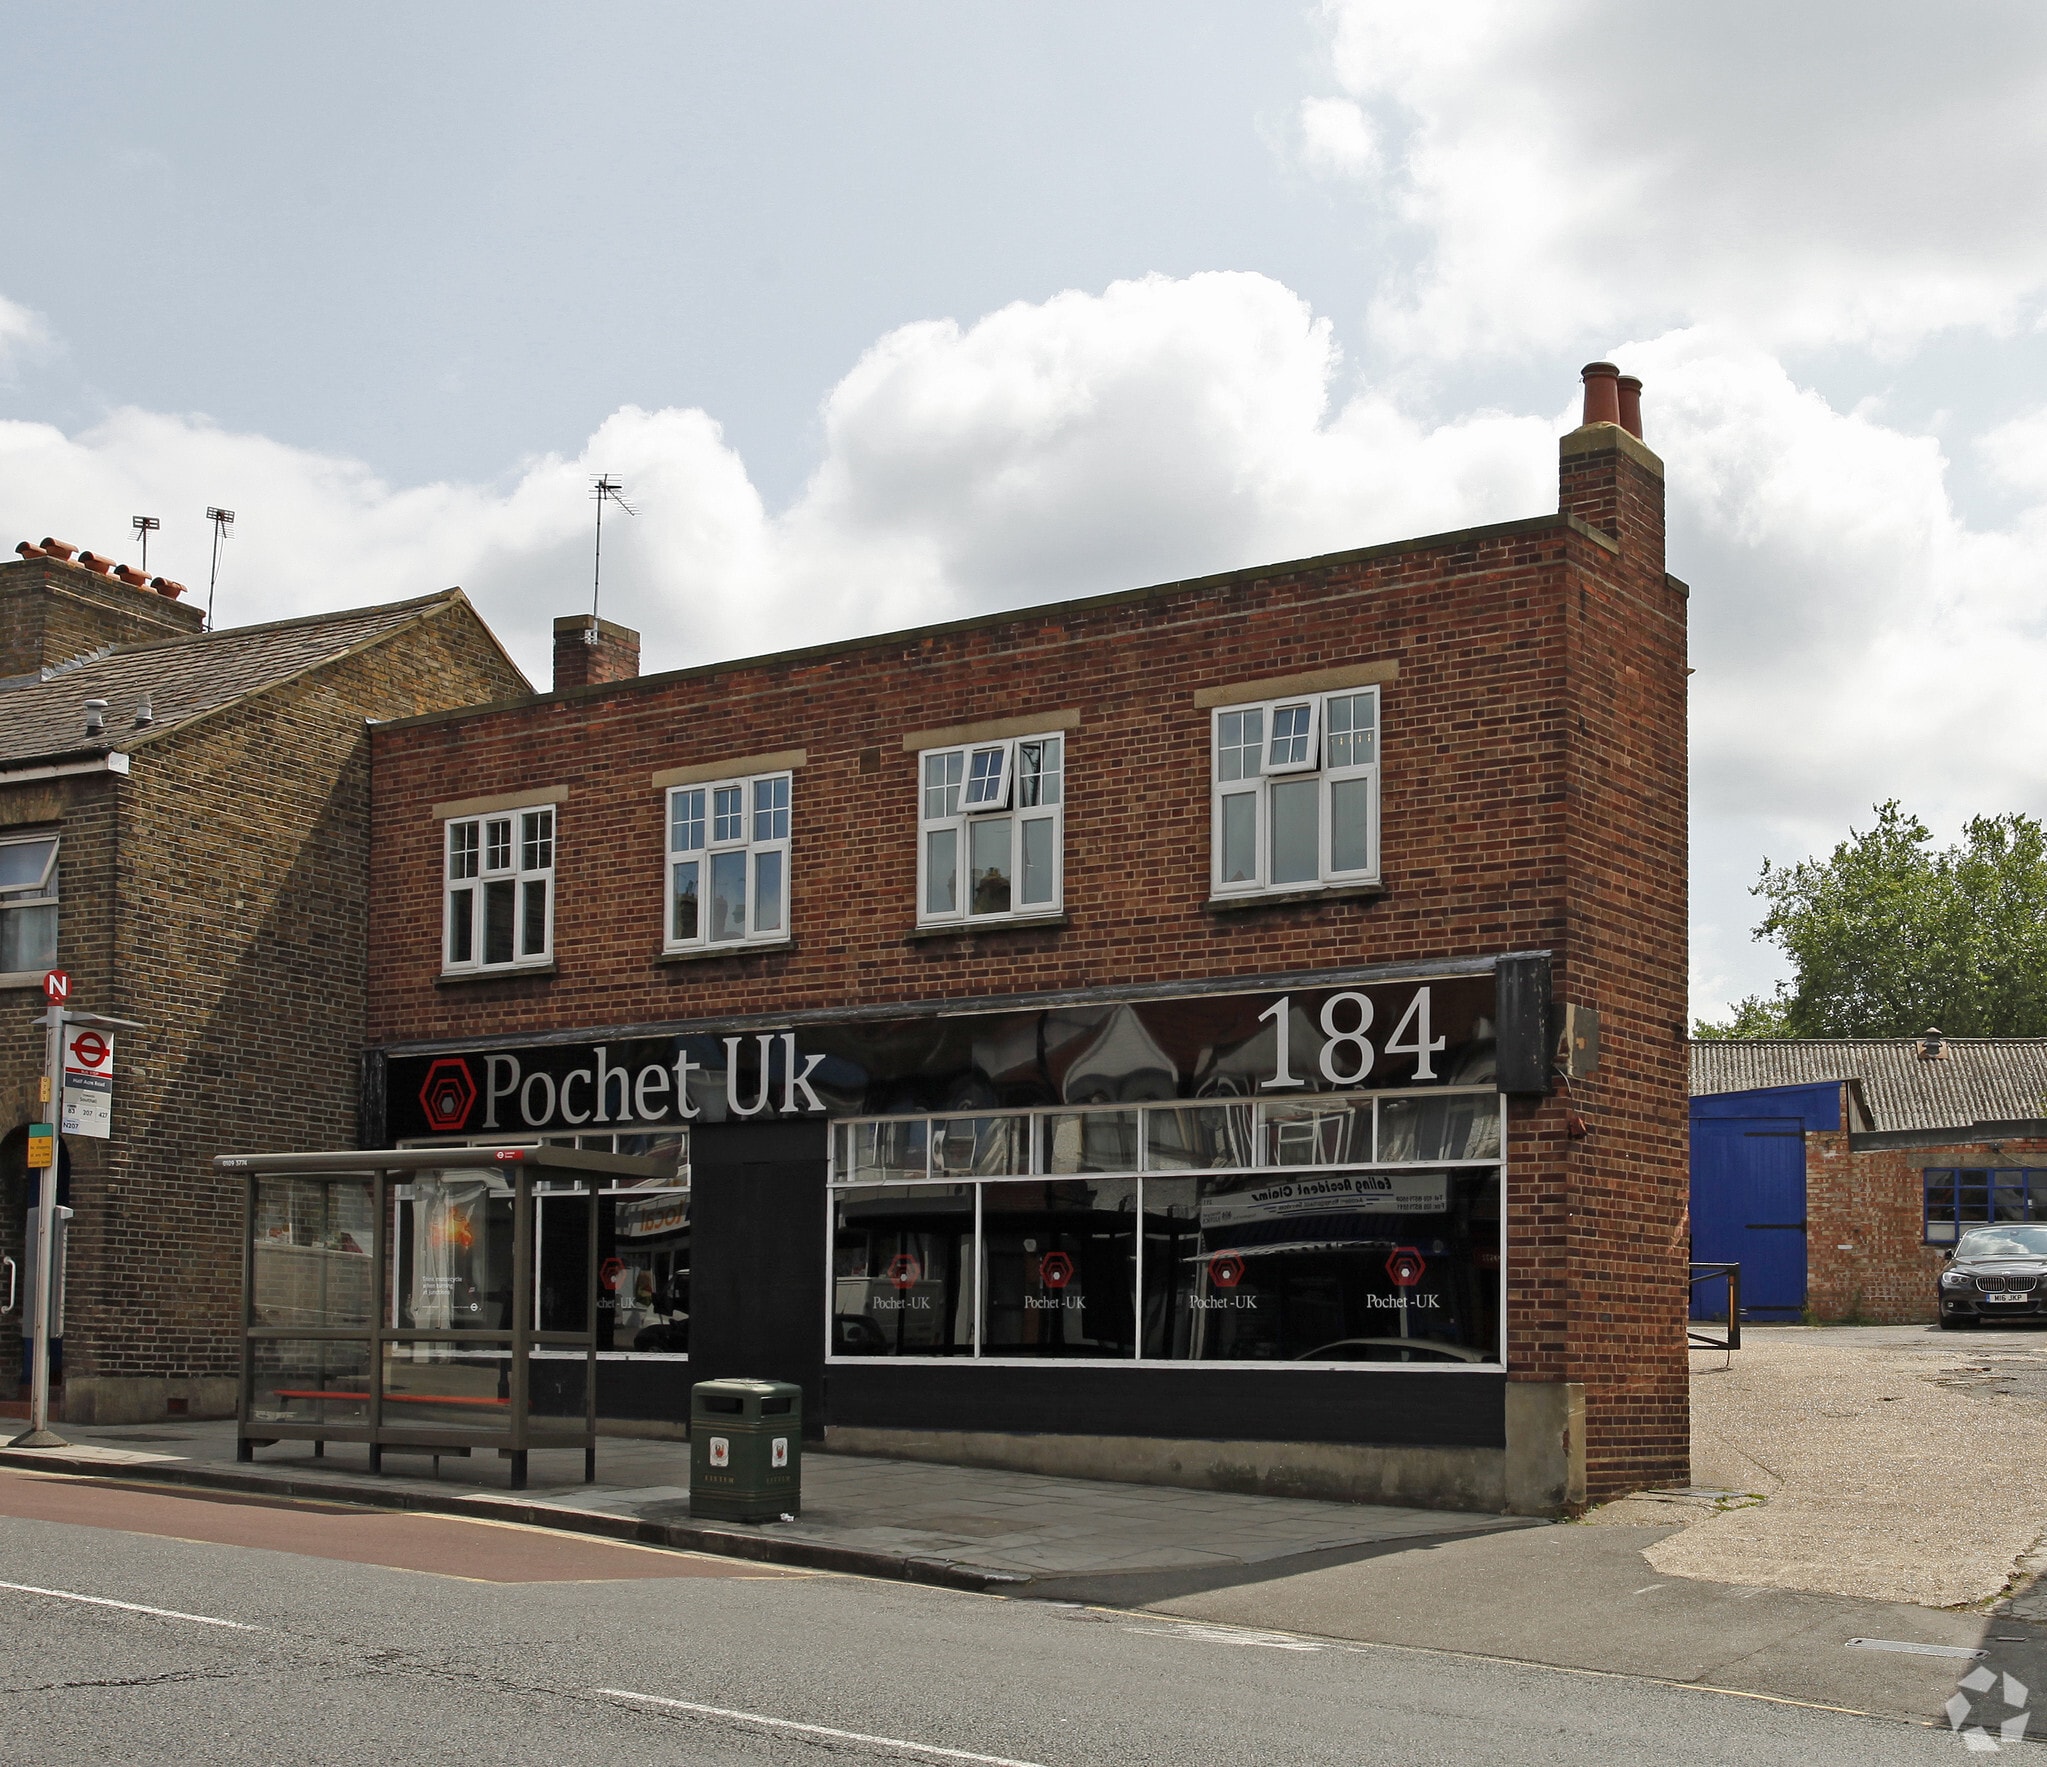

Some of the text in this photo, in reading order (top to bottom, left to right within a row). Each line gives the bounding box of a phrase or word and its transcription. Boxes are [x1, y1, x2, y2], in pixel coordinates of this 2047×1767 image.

[49, 975, 67, 996] N
[1258, 986, 1446, 1087] 184
[482, 1033, 827, 1129] Pochet Uk
[872, 1296, 906, 1310] Pochet
[1024, 1295, 1059, 1309] Pochet
[1189, 1295, 1228, 1309] Pochet
[1366, 1294, 1408, 1309] Pochet
